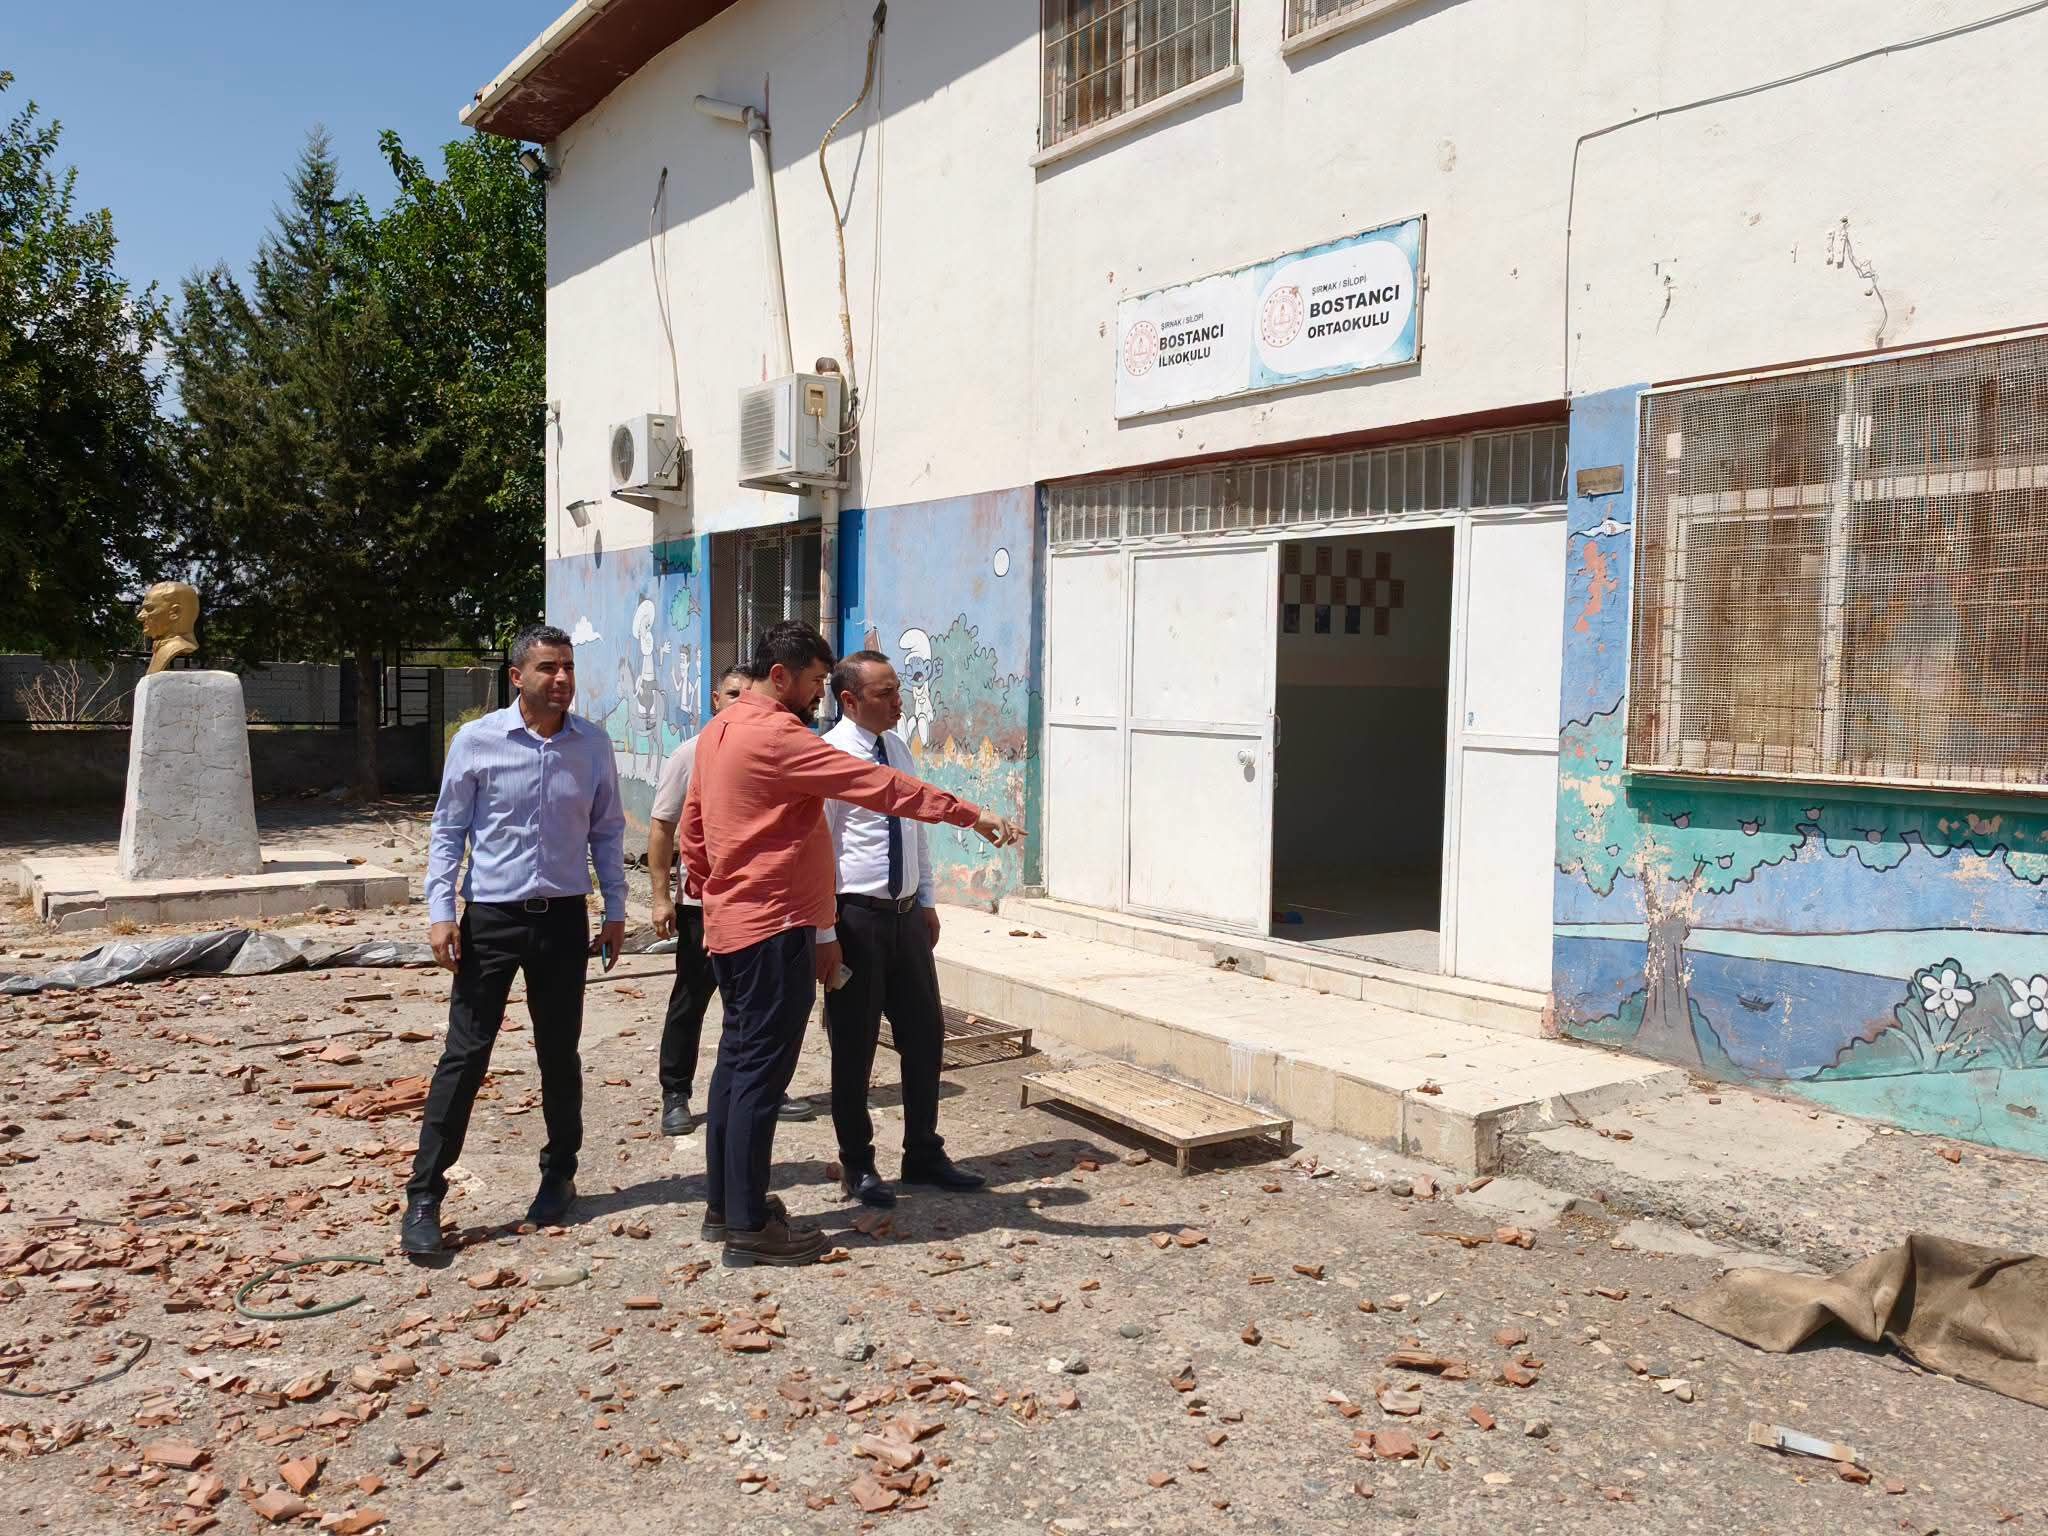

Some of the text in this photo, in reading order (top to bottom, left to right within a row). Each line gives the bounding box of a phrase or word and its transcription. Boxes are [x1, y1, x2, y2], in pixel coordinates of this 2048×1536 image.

[1309, 285, 1400, 318] BOSTANCI
[1159, 323, 1224, 351] BOSTANCI
[1307, 311, 1390, 339] ORTAOKULU
[1158, 347, 1211, 368] İLKOKULU
